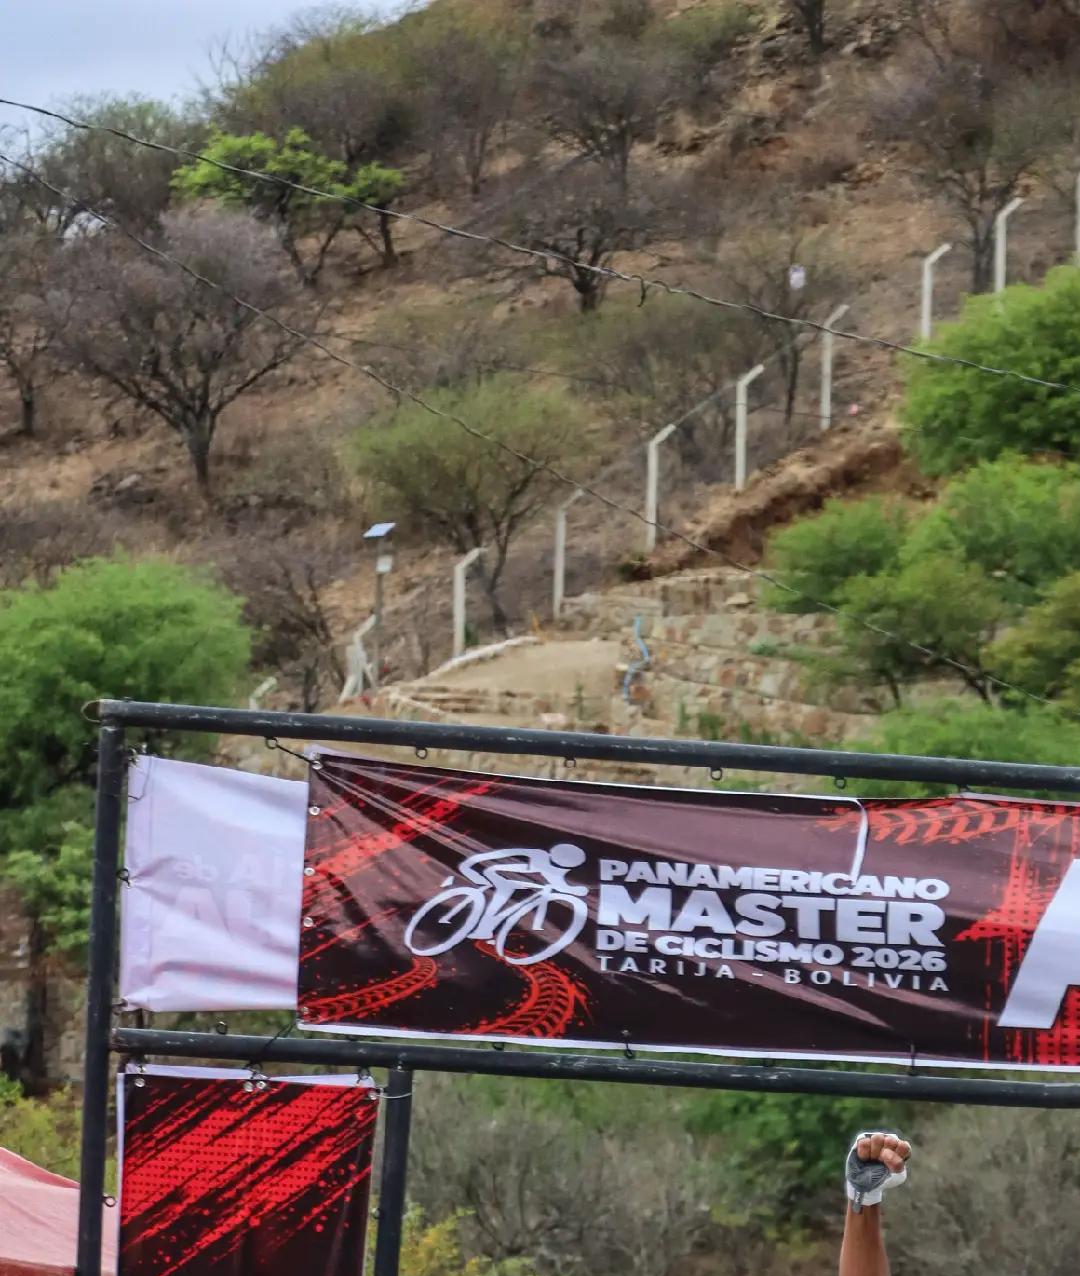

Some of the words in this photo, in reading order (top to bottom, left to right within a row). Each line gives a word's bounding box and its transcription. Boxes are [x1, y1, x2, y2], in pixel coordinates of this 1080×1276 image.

[599, 859, 950, 900] PANAMERICANO
[597, 884, 945, 947] MASTER
[596, 929, 649, 953] DE
[654, 935, 845, 965] CICLISMO
[851, 946, 947, 972] 2026
[597, 955, 736, 979] TARIJA
[784, 968, 949, 991] BOLIVIA
